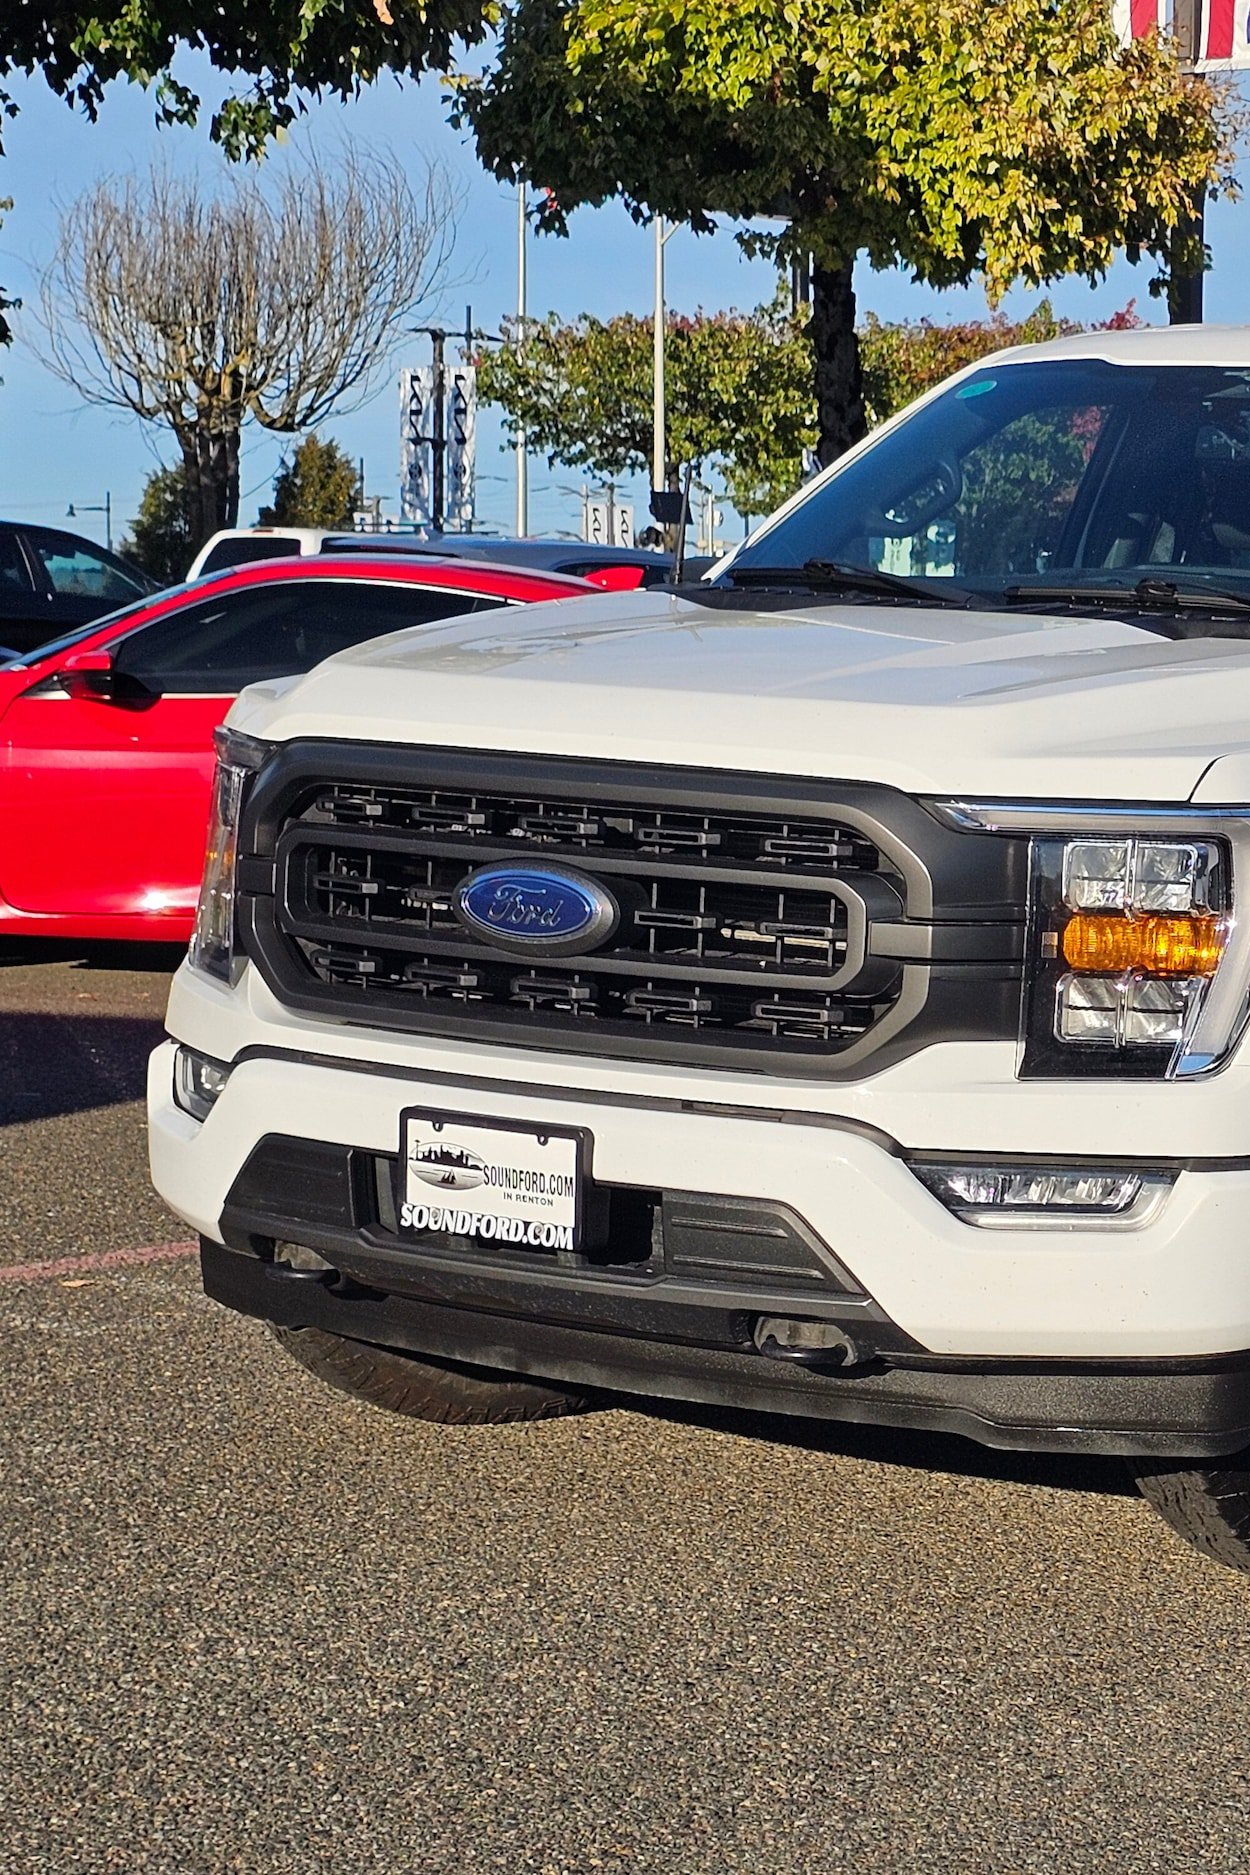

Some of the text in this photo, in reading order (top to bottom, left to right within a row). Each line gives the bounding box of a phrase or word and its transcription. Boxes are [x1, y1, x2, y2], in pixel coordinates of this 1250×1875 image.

[487, 883, 565, 927] Ford
[483, 1165, 574, 1198] SOUNDFORD.COM
[503, 1191, 554, 1207] IN RENTON
[400, 1204, 574, 1250] SOUNDFORD.COM
